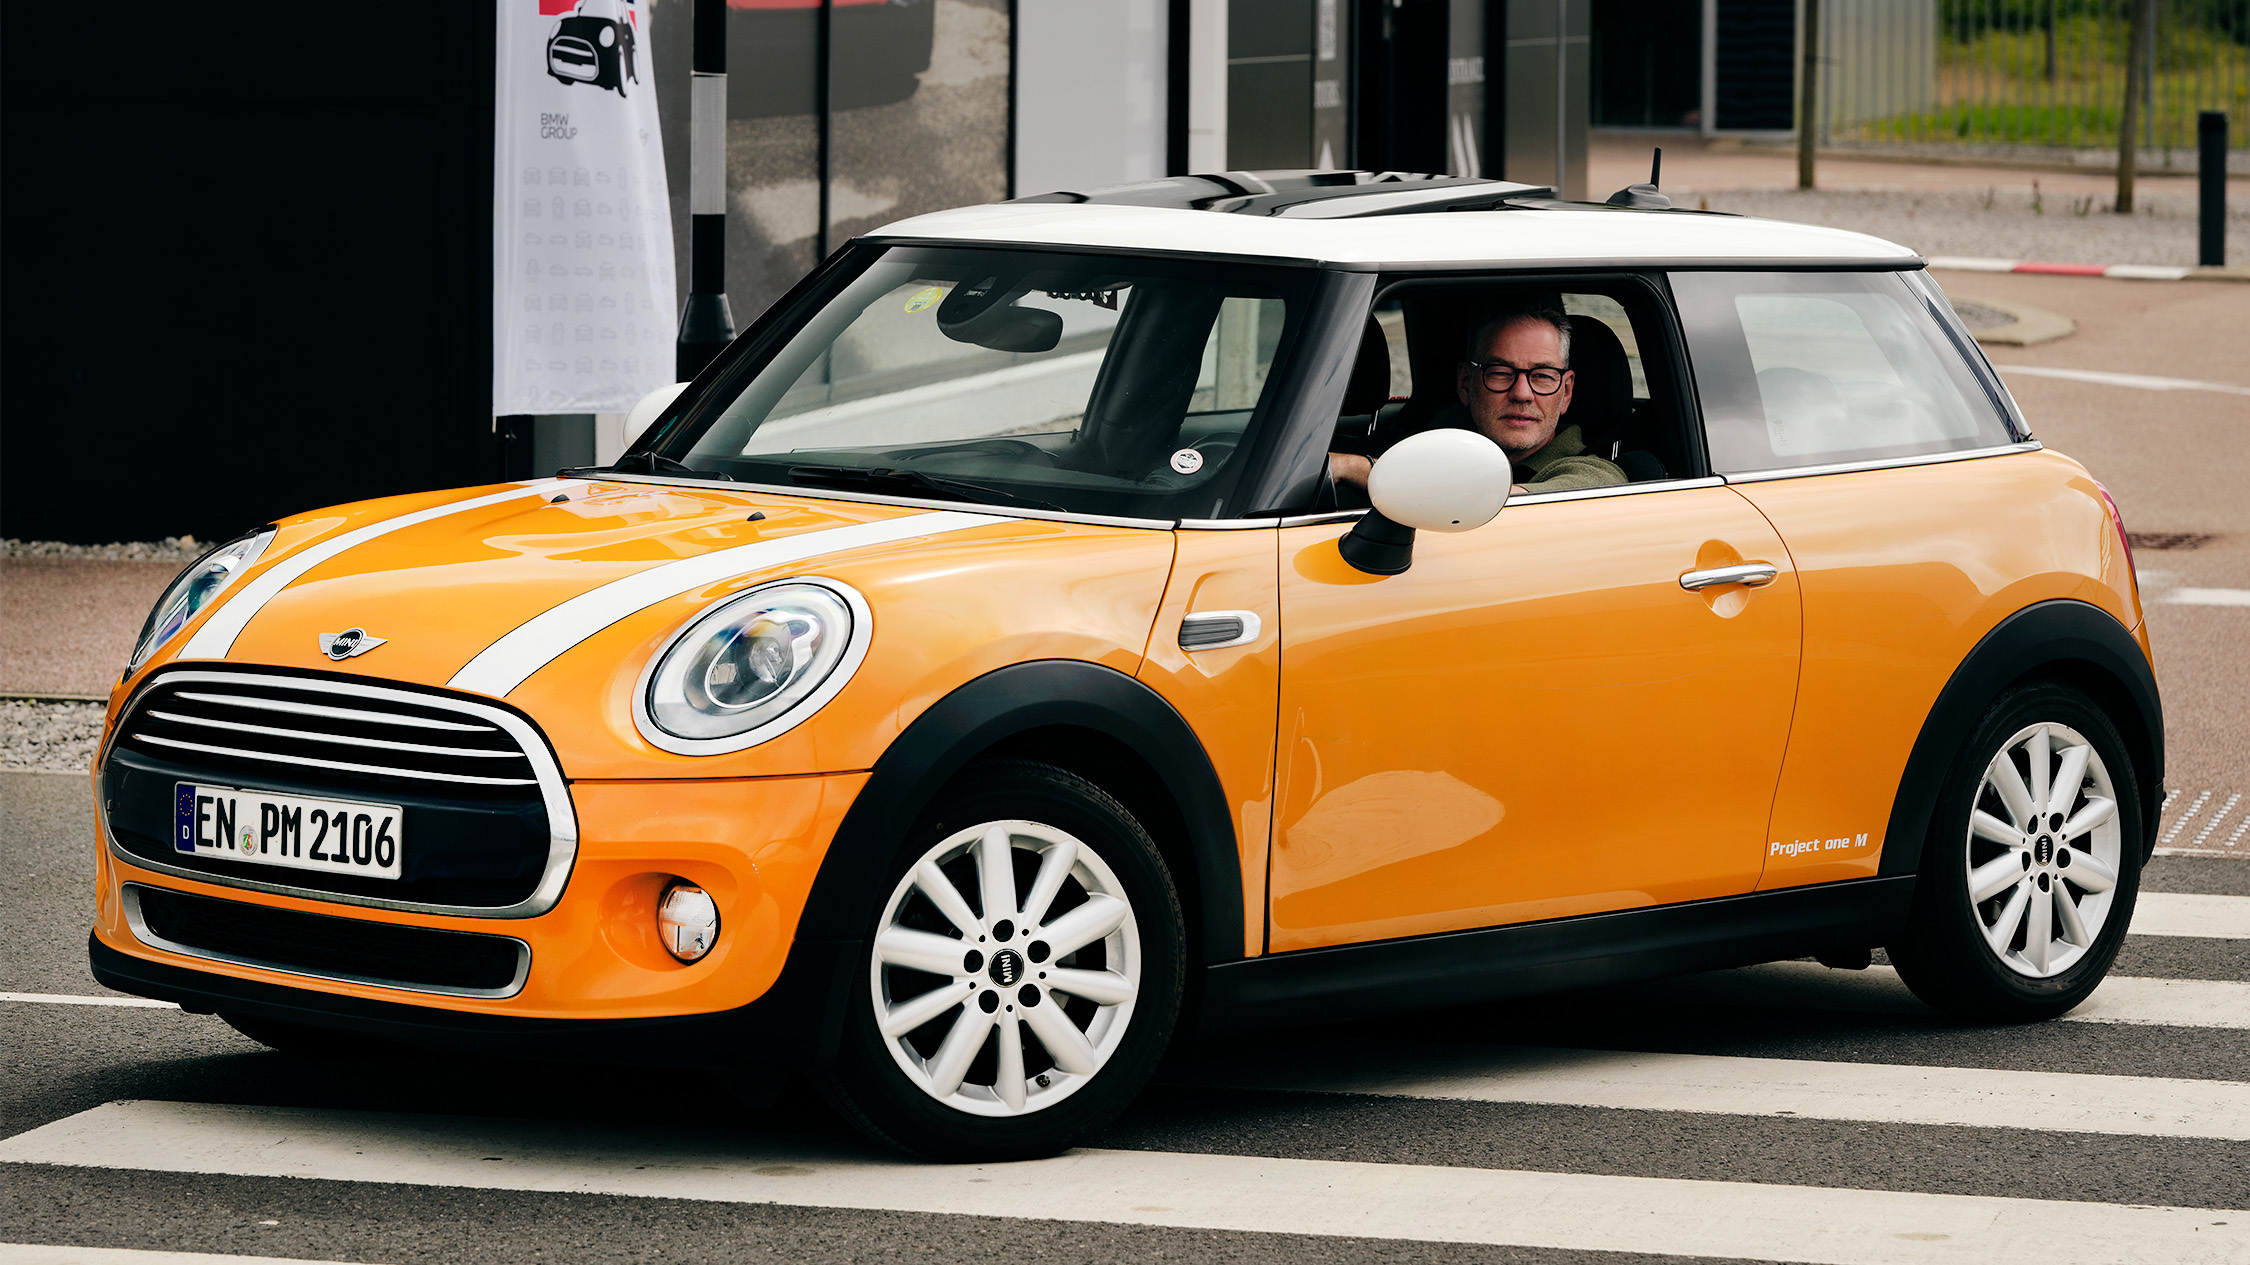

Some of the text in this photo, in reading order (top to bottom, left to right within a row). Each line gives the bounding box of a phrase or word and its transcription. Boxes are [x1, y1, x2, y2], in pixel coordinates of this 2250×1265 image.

[540, 113, 569, 125] BMW
[540, 126, 578, 140] GROUP
[334, 637, 360, 648] MINI
[182, 825, 190, 840] D
[196, 795, 236, 850] EN
[260, 802, 302, 858] PM
[309, 809, 396, 868] 2106
[1770, 833, 1868, 857] Project one M
[1001, 954, 1013, 983] MINI
